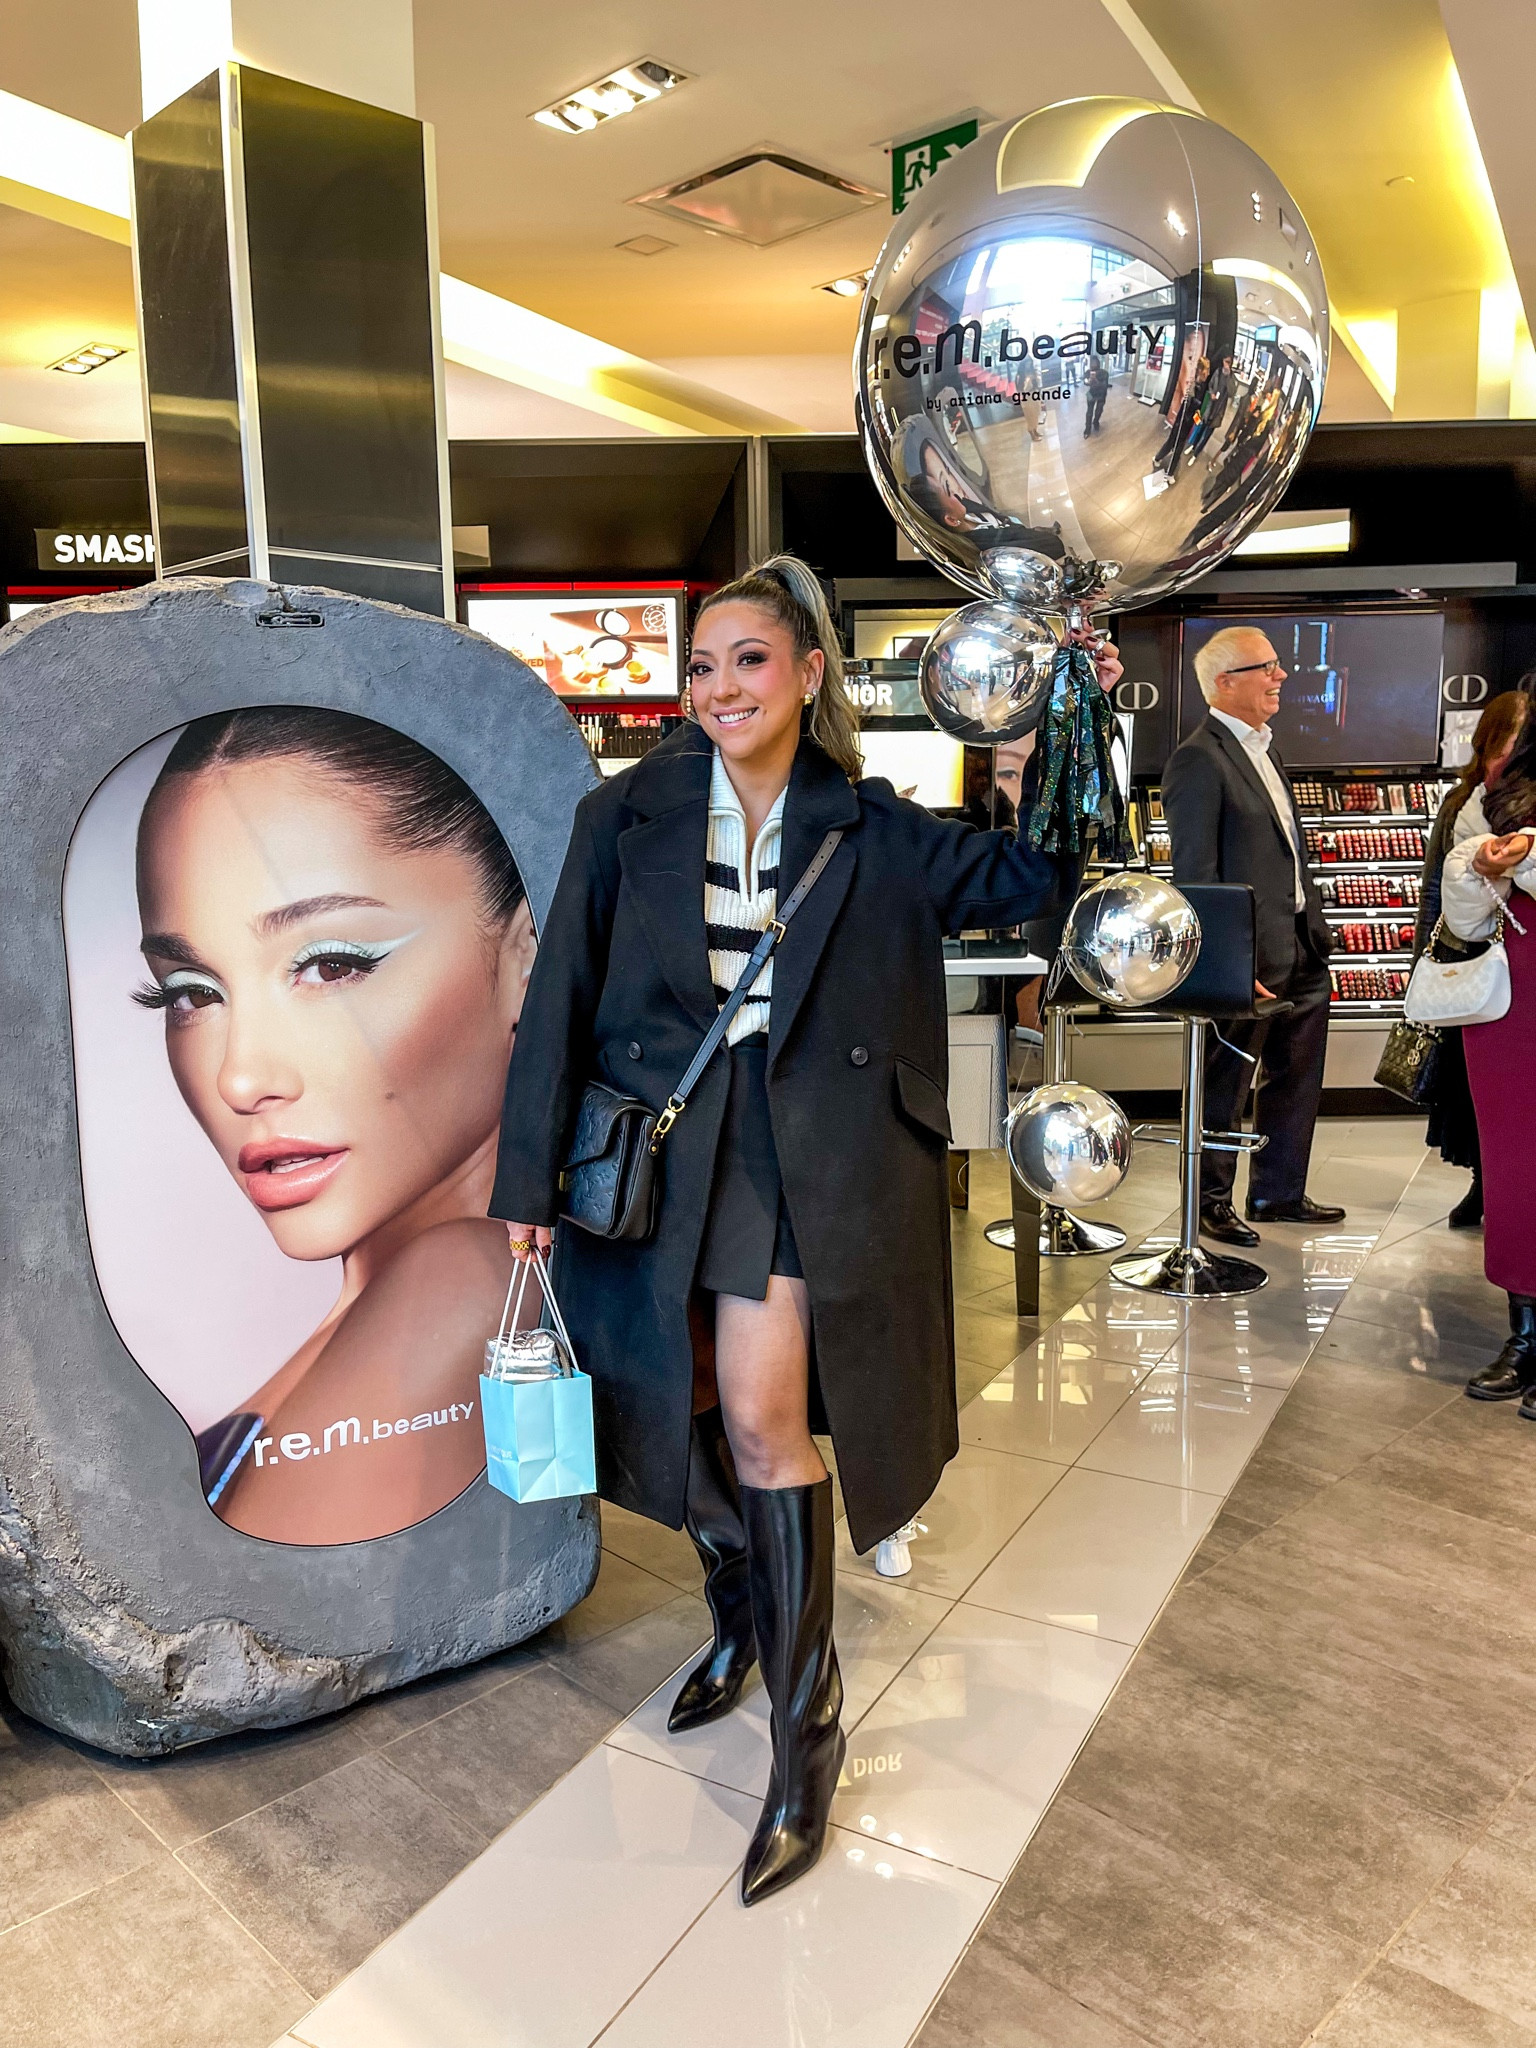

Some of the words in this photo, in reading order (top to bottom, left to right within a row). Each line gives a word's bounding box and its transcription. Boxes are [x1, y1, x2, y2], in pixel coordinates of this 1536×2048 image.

[926, 396, 942, 412] by
[950, 390, 1002, 408] ariana
[1012, 386, 1071, 406] grande
